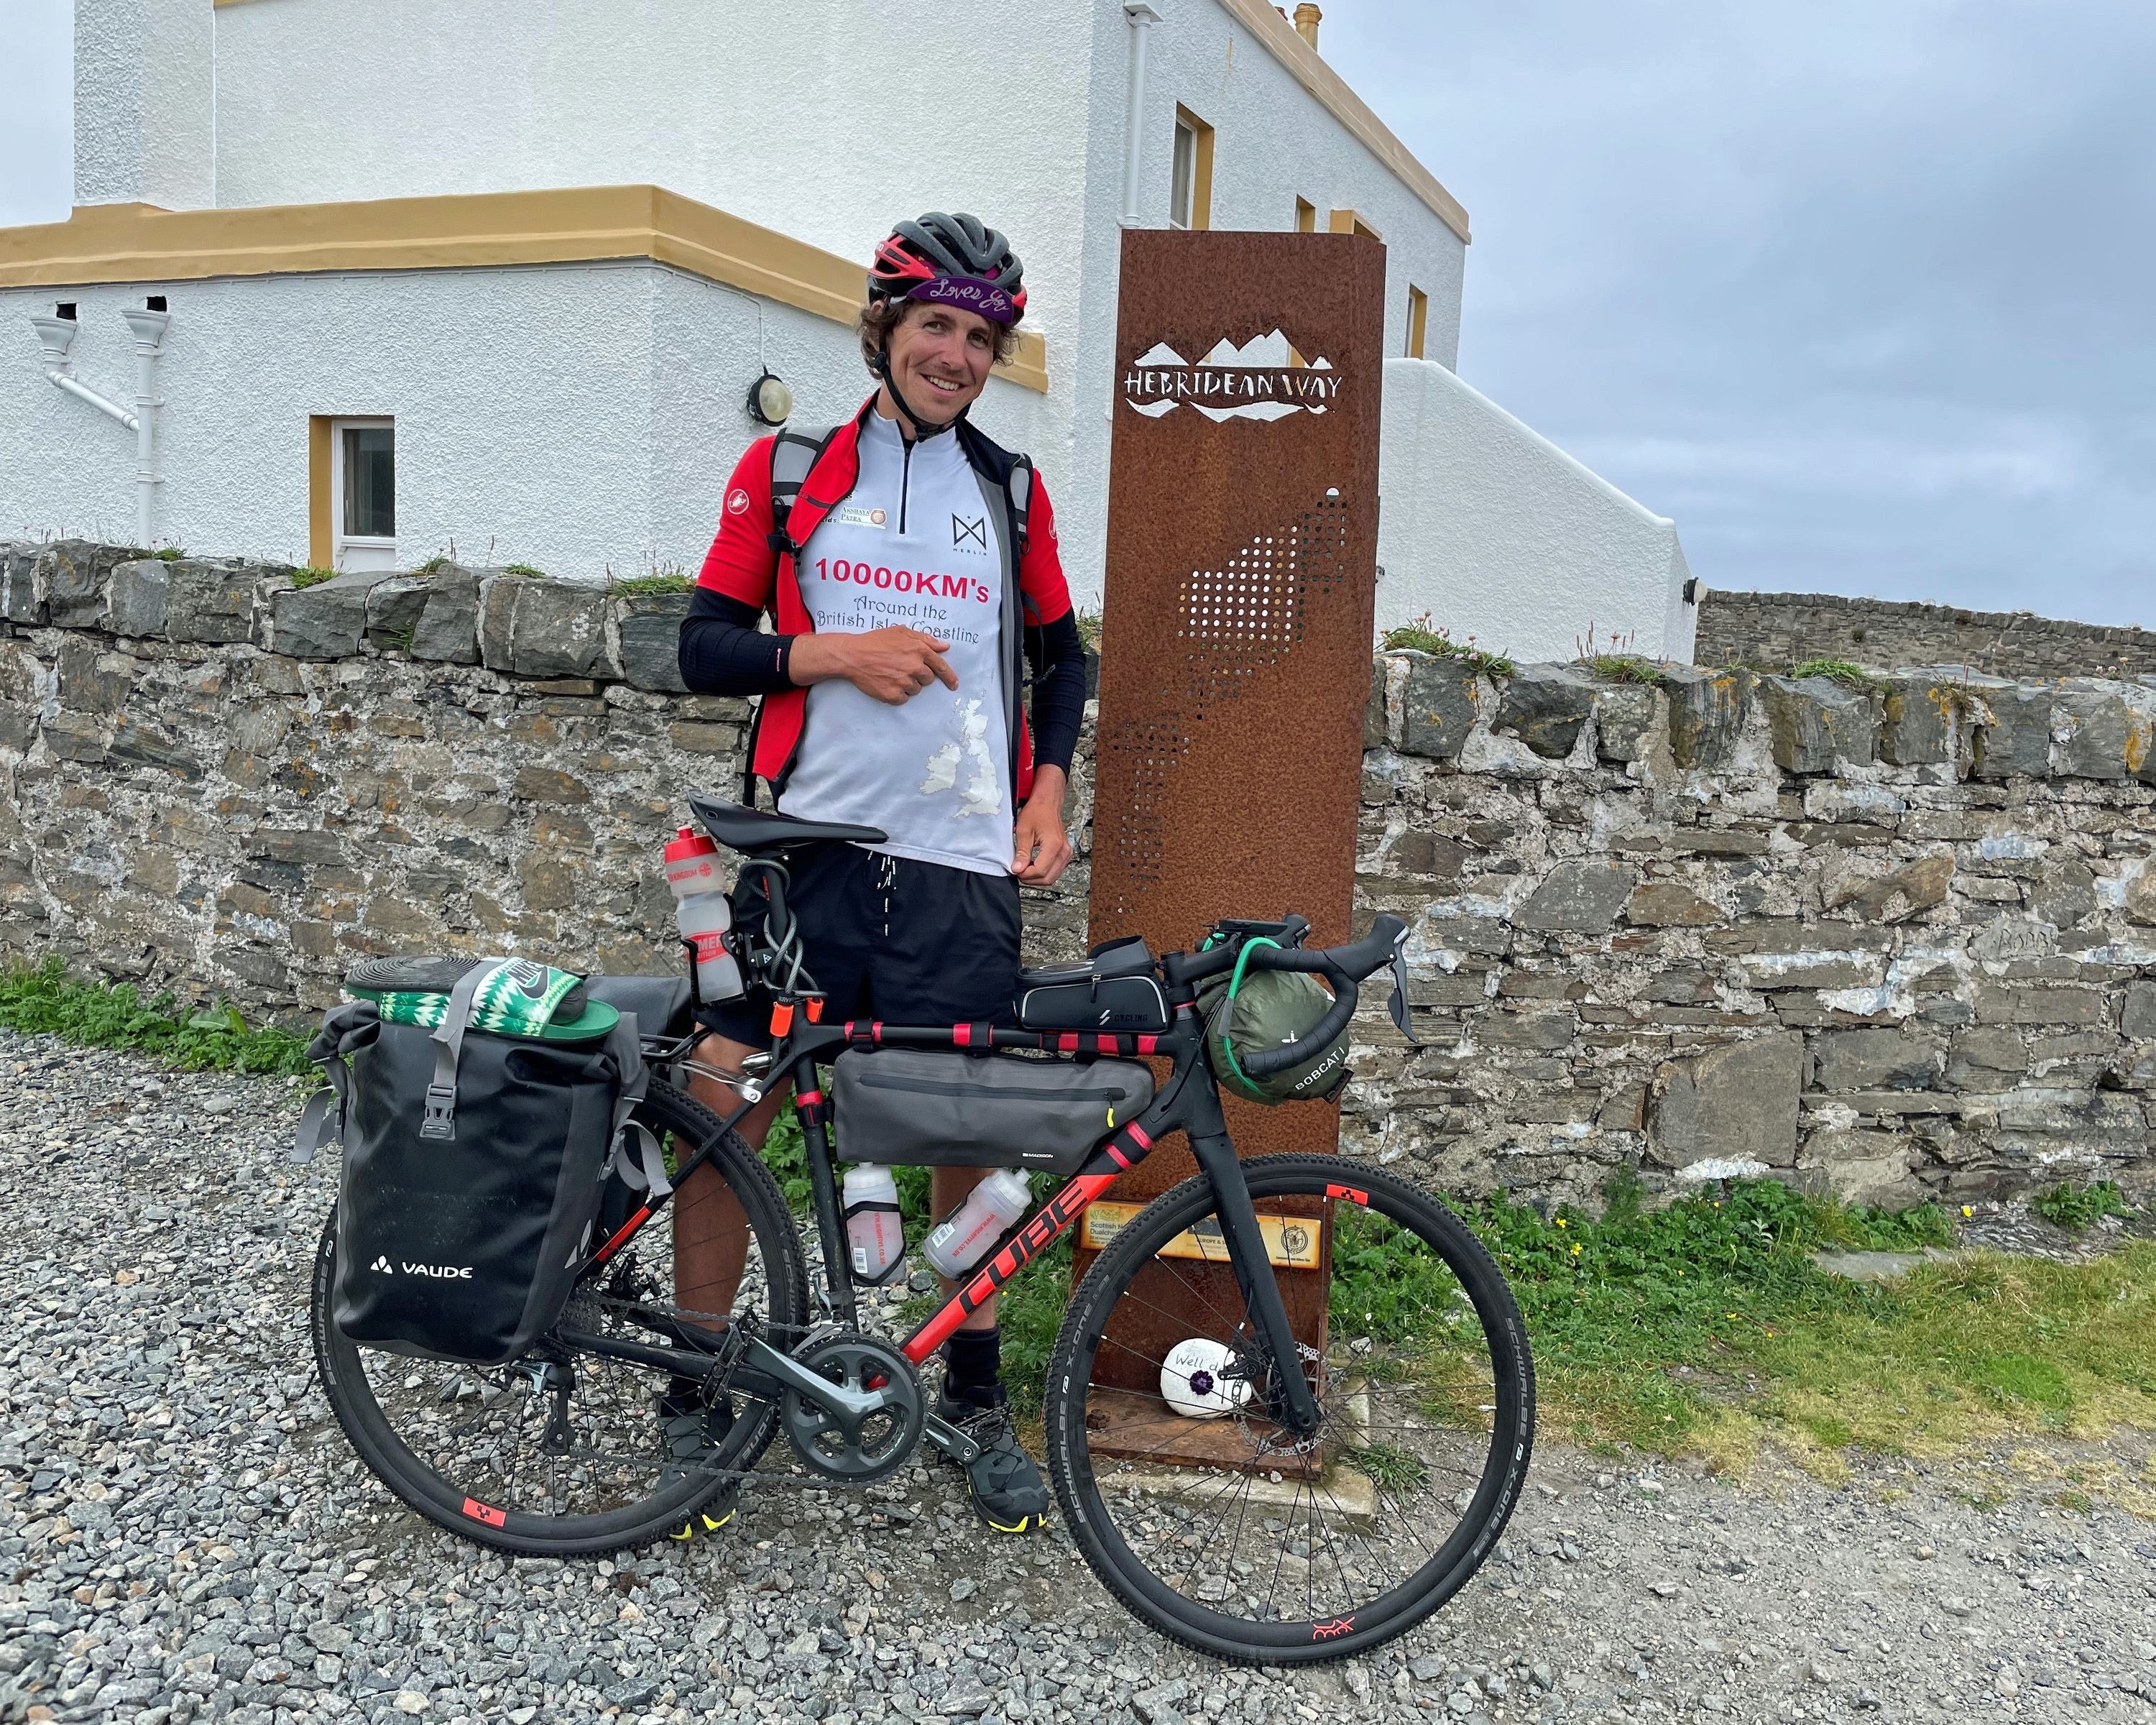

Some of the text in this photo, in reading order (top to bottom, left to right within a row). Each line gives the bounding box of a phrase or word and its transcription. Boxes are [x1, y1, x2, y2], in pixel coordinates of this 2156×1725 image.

[930, 279, 983, 299] Loves
[1124, 369, 1342, 397] HEBRIDEAN WAY
[816, 558, 990, 603] 10000KM's
[816, 611, 865, 628] British
[853, 595, 948, 621] Around the
[1295, 1050, 1340, 1090] BOBCAT
[959, 1179, 1088, 1315] CUBE
[402, 1262, 474, 1279] VAUDE
[318, 1263, 337, 1385] SCHWALBE
[1176, 1353, 1204, 1368] Well
[1505, 1317, 1528, 1438] SCHWALBE
[1059, 1401, 1086, 1523] SCHWALBE
